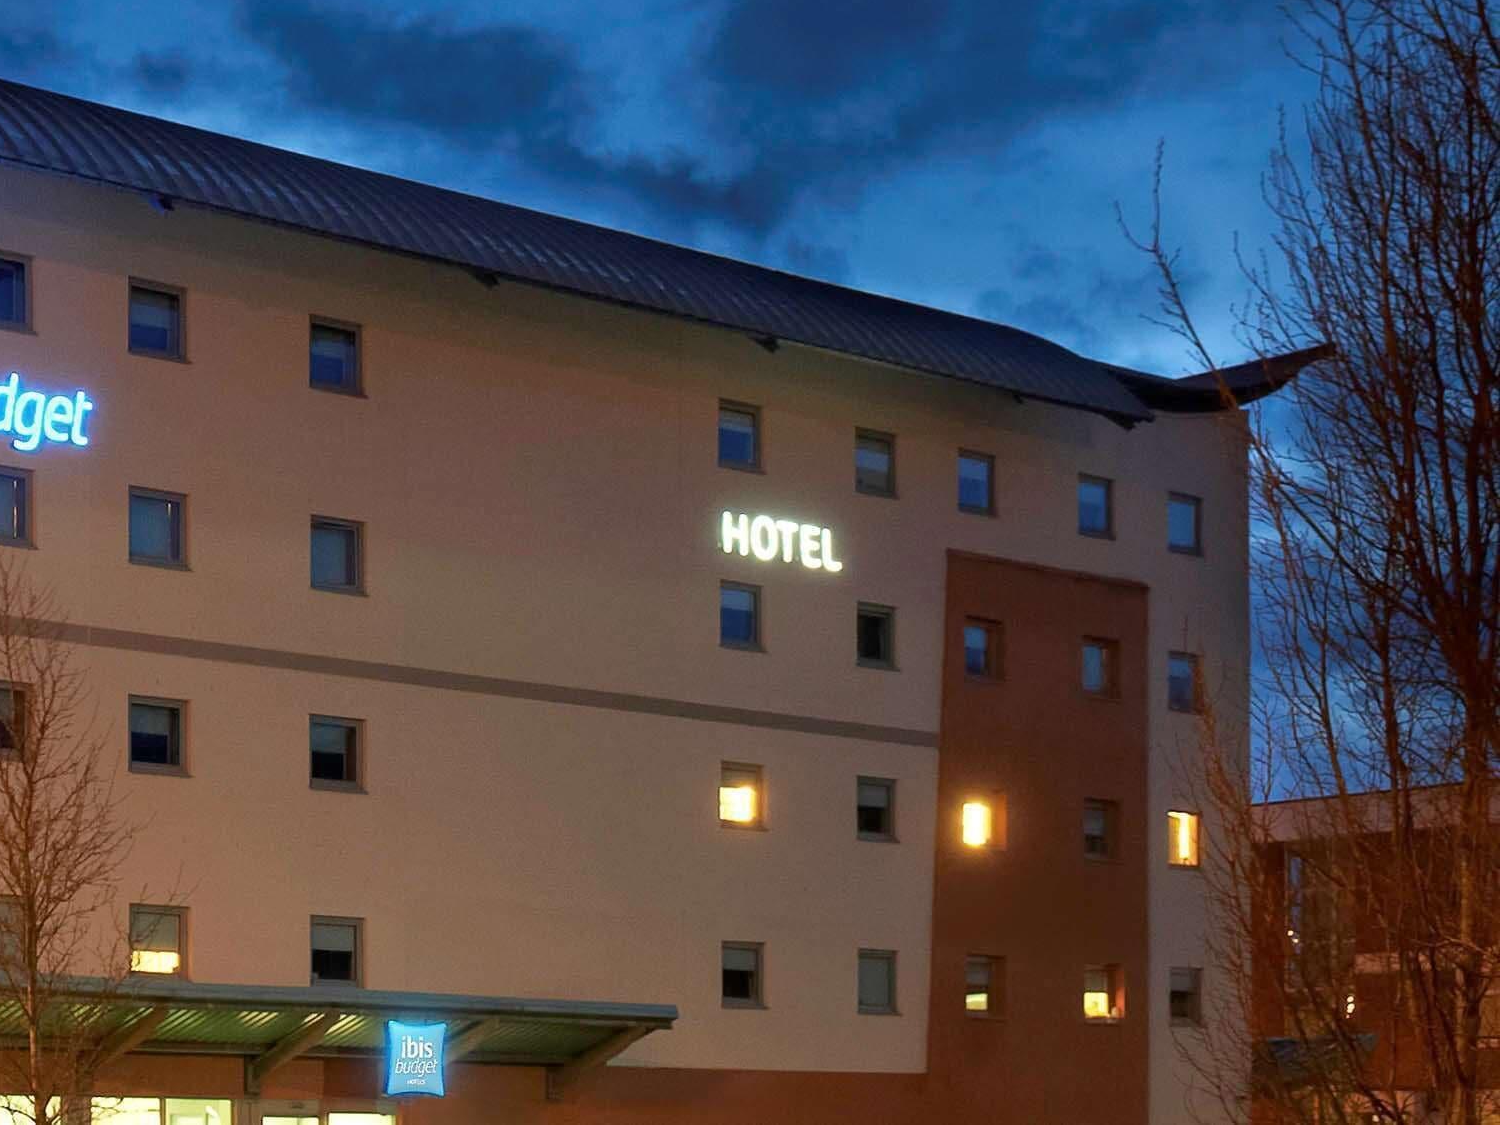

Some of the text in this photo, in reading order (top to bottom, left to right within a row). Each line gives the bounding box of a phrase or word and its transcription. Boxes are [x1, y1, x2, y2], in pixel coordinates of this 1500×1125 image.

[722, 511, 843, 572] HOTEL
[401, 1035, 433, 1058] ibis
[395, 1058, 438, 1077] budget
